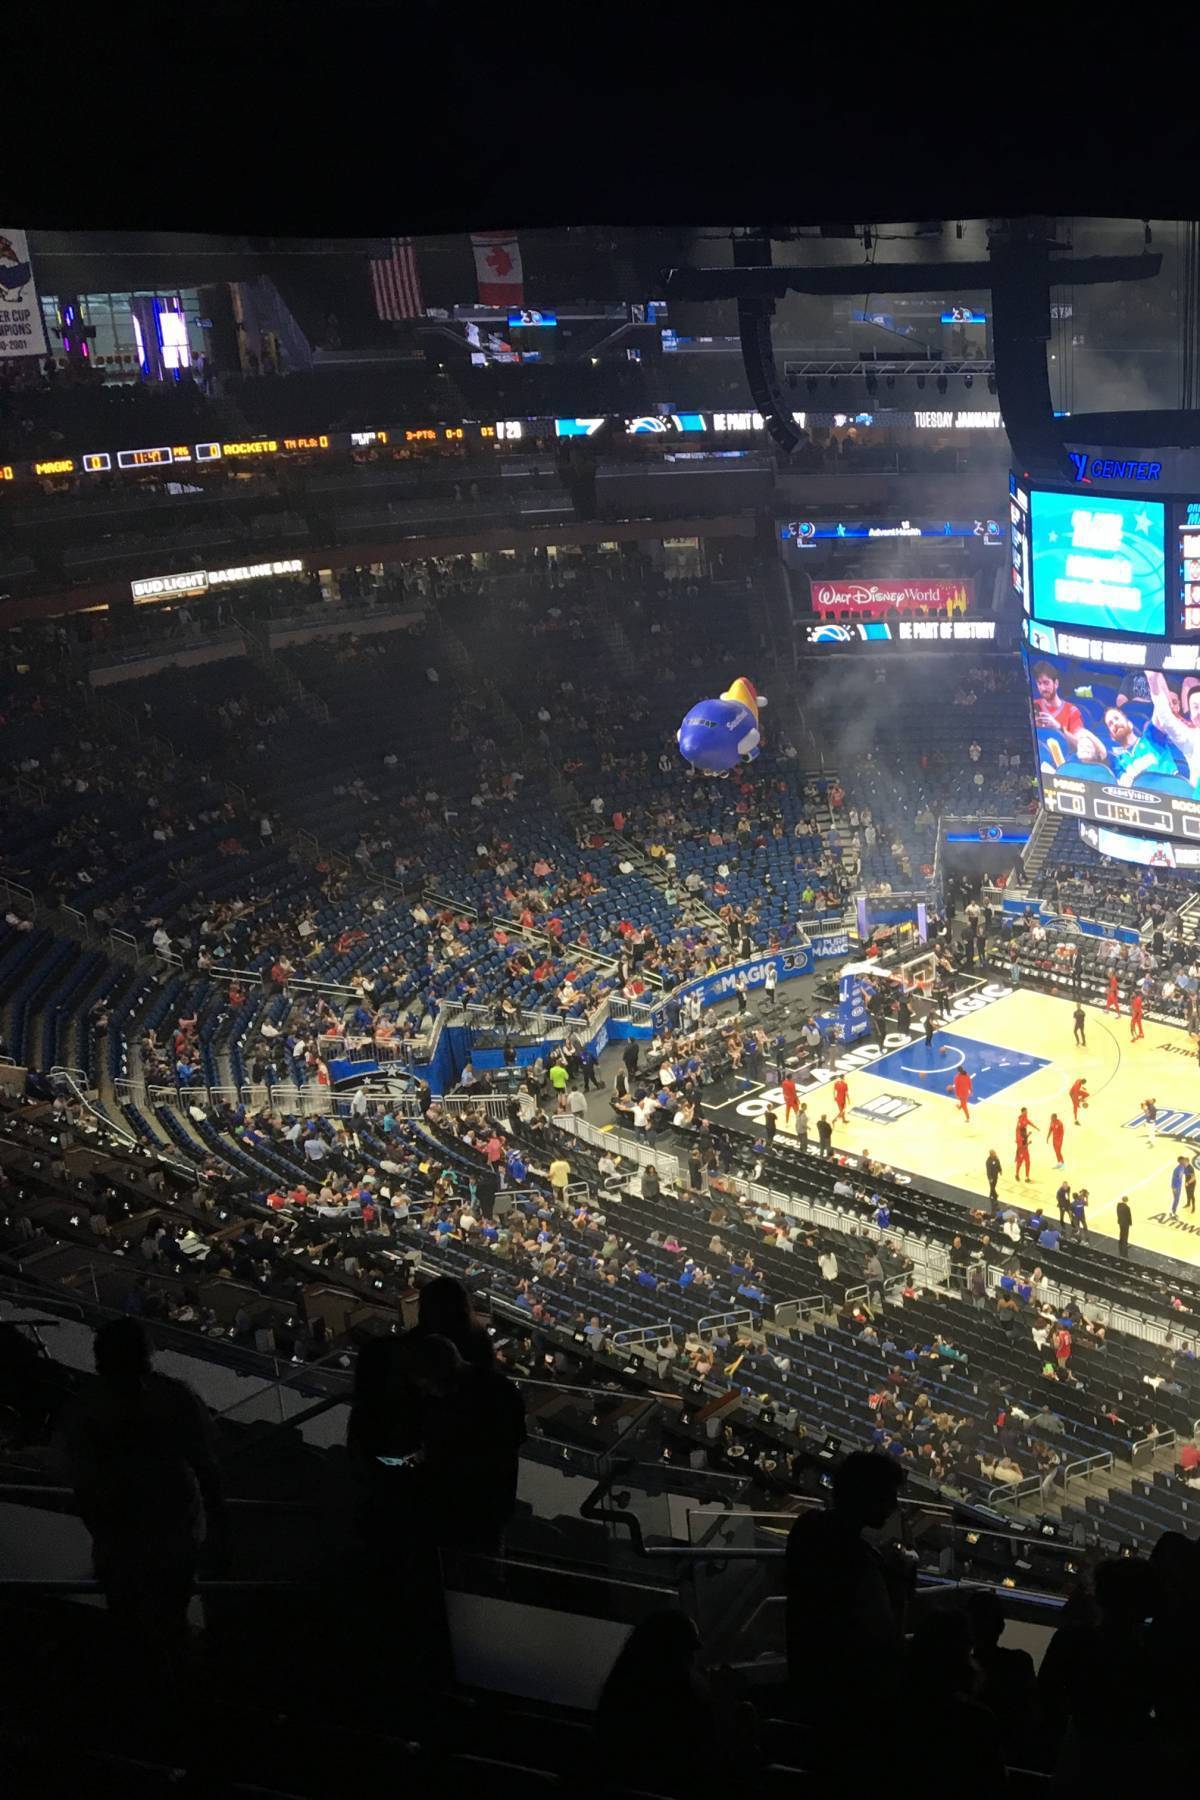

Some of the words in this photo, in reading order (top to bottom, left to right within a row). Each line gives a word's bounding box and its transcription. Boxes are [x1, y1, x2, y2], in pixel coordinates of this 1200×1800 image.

[11, 309, 31, 320] CUP
[914, 411, 953, 427] TUESDAY
[955, 411, 1002, 428] JANUARY
[319, 435, 328, 448] 0
[36, 460, 74, 475] MAGIC
[91, 456, 101, 469] 0
[209, 444, 217, 457] 0
[223, 441, 277, 456] ROCKETS
[1091, 460, 1162, 480] CENTER
[134, 580, 164, 596] BUD
[165, 574, 206, 591] LIGHT
[208, 564, 272, 585] BASELINE
[274, 559, 302, 574] BAR
[905, 588, 940, 602] World
[900, 622, 912, 639] BE
[914, 622, 939, 639] PART
[940, 622, 953, 639] OF
[954, 622, 995, 639] HISTORY
[812, 943, 849, 957] MAGIC
[823, 936, 849, 947] PURE
[782, 951, 808, 972] 30
